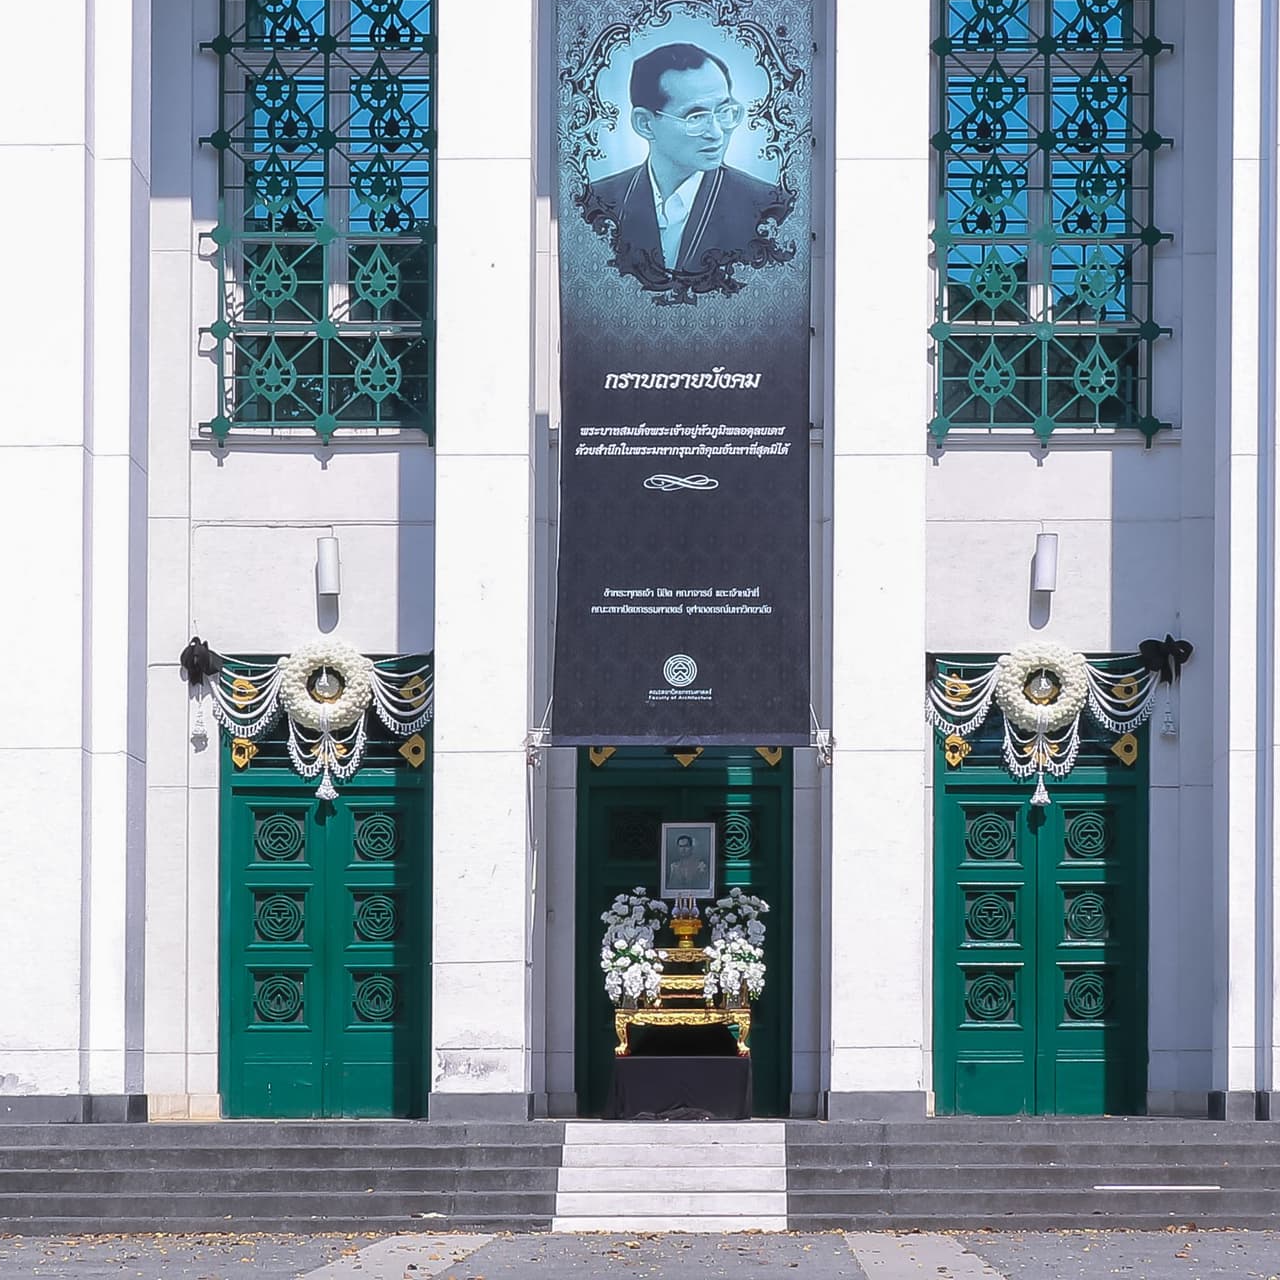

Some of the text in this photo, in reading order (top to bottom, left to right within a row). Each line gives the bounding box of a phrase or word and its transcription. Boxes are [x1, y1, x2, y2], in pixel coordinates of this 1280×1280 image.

[604, 367, 762, 390] กราบถวายบังคม
